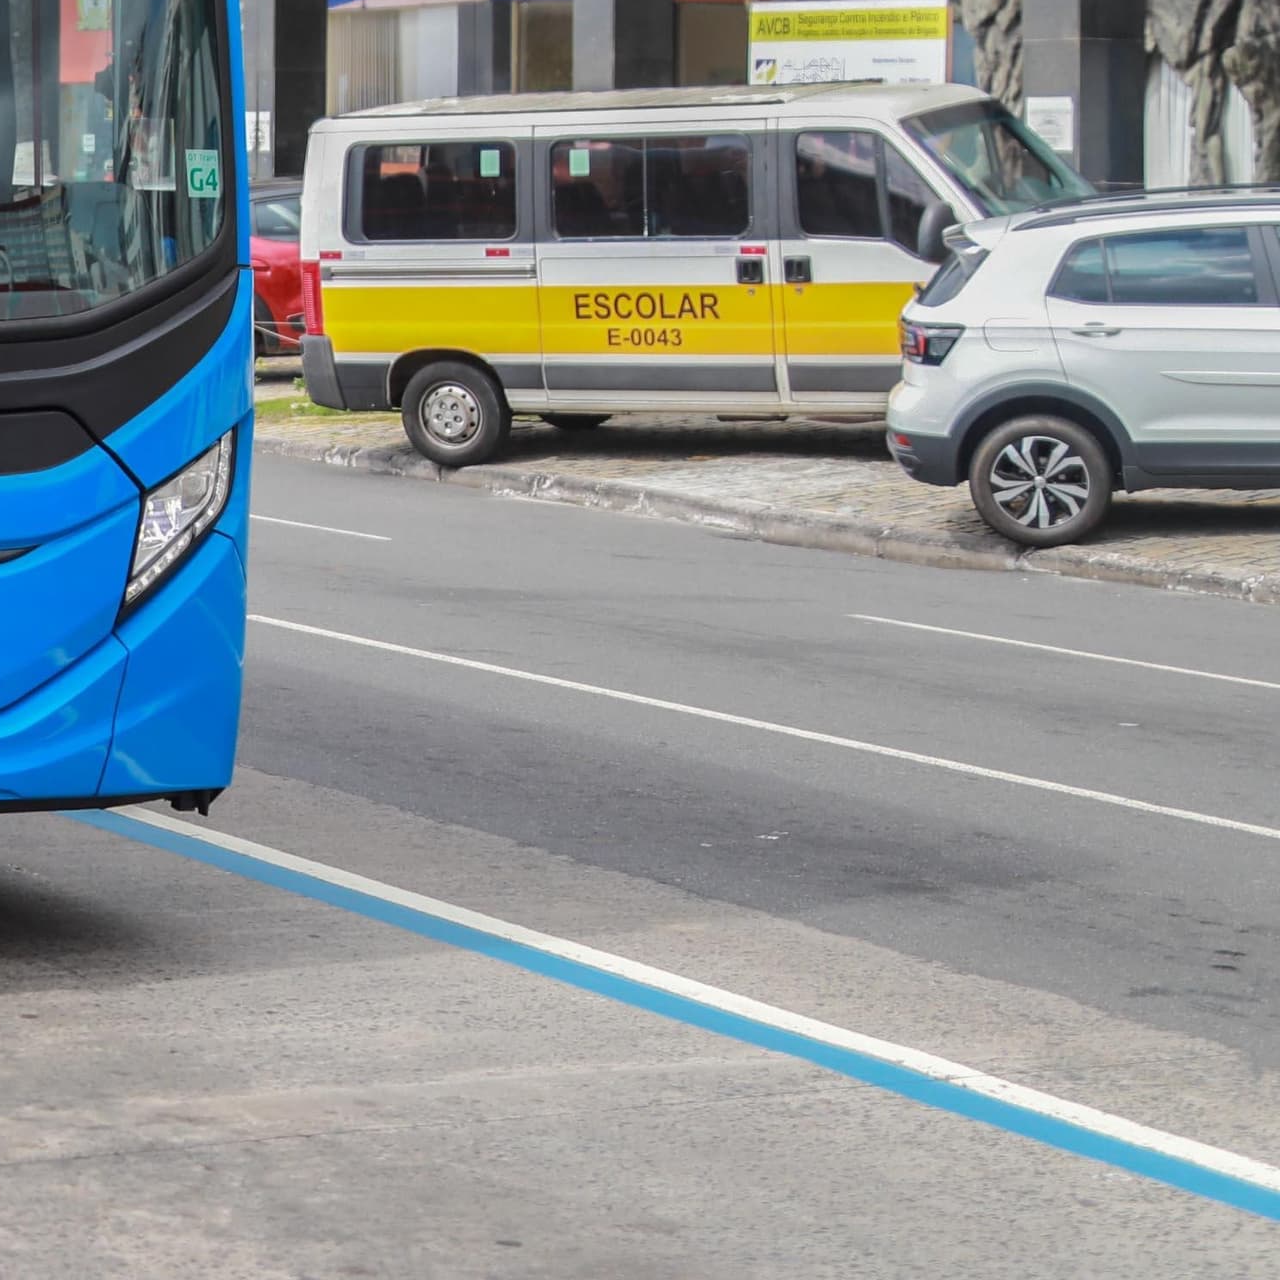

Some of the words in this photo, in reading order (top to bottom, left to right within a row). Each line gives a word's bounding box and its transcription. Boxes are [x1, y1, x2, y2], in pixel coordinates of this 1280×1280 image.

[756, 17, 790, 36] AVCB
[190, 167, 218, 191] G4
[574, 291, 721, 320] ESCOLAR
[607, 328, 682, 346] E-0043
